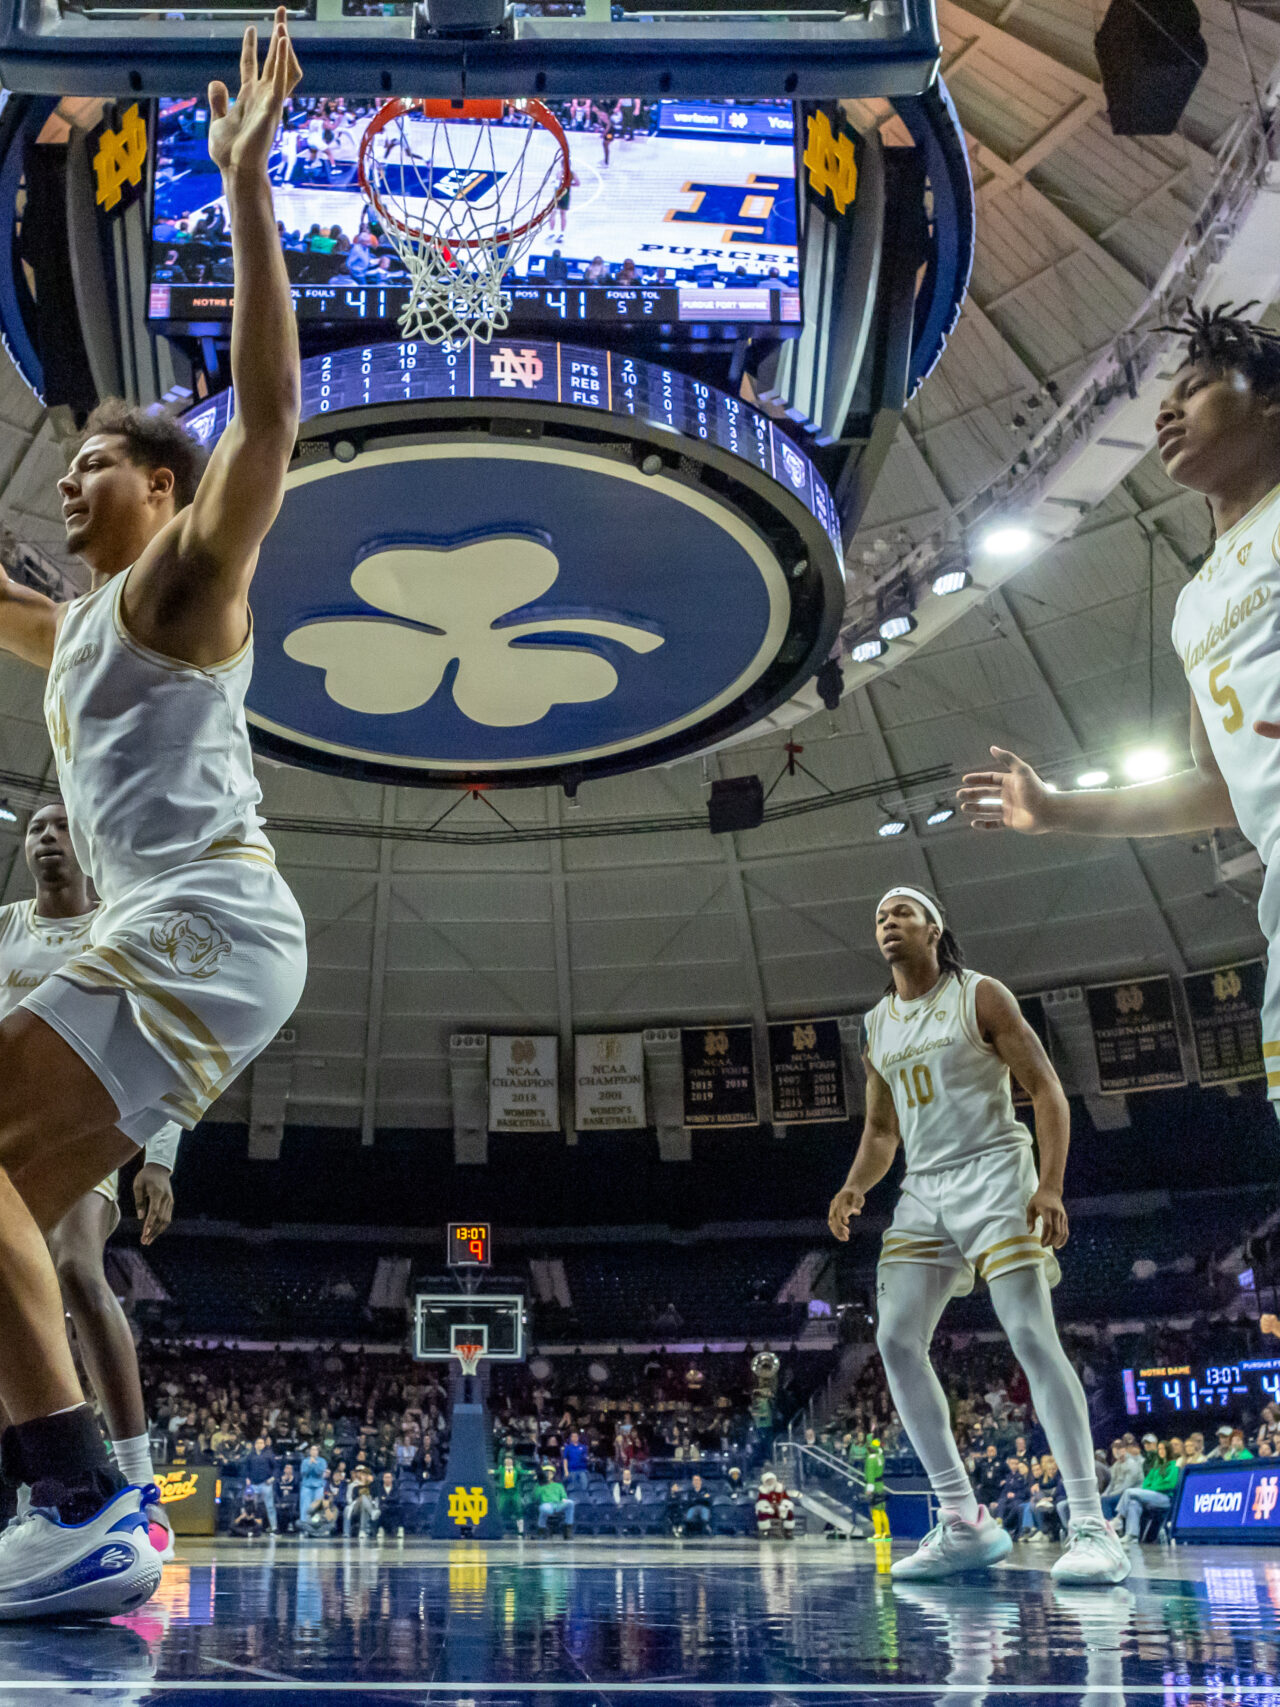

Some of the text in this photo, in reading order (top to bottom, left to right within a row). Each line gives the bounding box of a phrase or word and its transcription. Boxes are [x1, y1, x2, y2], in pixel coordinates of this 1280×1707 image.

[305, 290, 336, 298] FOULS
[606, 291, 660, 300] FOULS TOL
[192, 298, 226, 307] NOTRE
[346, 290, 386, 318] 41
[546, 291, 586, 319] 41
[643, 300, 654, 314] 2
[321, 356, 332, 370] 2
[362, 349, 373, 361] 5
[397, 343, 418, 356] 10
[321, 354, 457, 382] 5 0 19 0
[320, 370, 456, 397] 0 1 4 1
[623, 359, 634, 373] 2
[662, 371, 672, 384] 5
[692, 382, 709, 399] 10
[724, 397, 740, 414] 13
[320, 384, 456, 411] 0 1 1 1
[570, 375, 600, 391] REB
[624, 387, 634, 399] 4
[663, 398, 673, 411] 0
[571, 361, 599, 377] PTS
[621, 372, 638, 385] 10
[663, 385, 673, 397] 2
[728, 412, 737, 426] 2
[573, 391, 600, 406] FLS
[626, 402, 635, 415] 1
[665, 413, 673, 425] 1
[699, 426, 708, 439] 0
[1208, 655, 1245, 735] 5
[506, 1067, 541, 1077] NCAA
[593, 1065, 627, 1074] NCAA
[775, 1062, 805, 1072] FINAL
[492, 1078, 555, 1087] CHAMPION
[579, 1075, 641, 1086] CHAMPION
[900, 1063, 935, 1109] 10
[511, 1093, 537, 1102] 2018
[503, 1108, 546, 1117] WOMEN'S
[590, 1106, 632, 1115] WOMEN'S
[497, 1119, 552, 1127] BASKETBALL
[583, 1116, 639, 1125] BASKETBALL
[456, 1227, 486, 1240] 13:07
[469, 1240, 484, 1261] 9
[1140, 1365, 1191, 1377] NOTRE DAME
[1206, 1366, 1241, 1385] 13:07
[1163, 1378, 1198, 1410] 41
[1193, 1487, 1243, 1513] verizon
